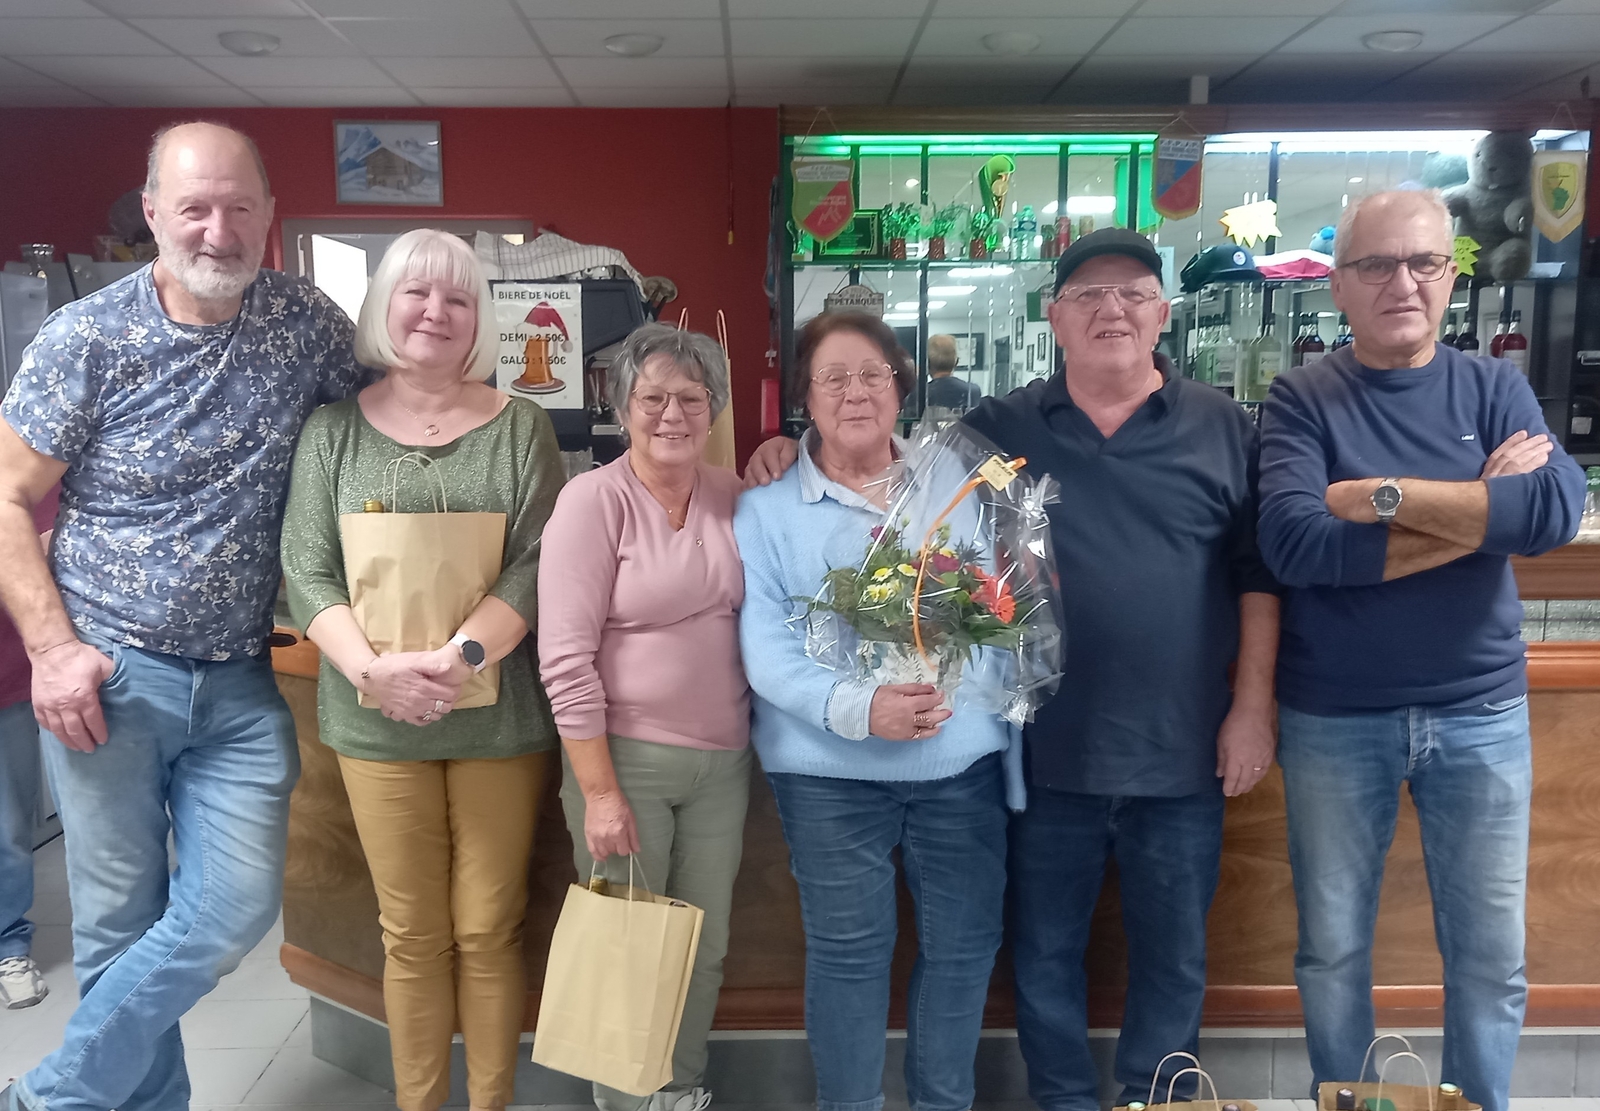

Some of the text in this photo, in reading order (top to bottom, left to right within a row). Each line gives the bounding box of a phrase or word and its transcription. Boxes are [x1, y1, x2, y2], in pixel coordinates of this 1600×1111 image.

[528, 291, 543, 300] DE
[500, 333, 527, 342] DEMI
[500, 356, 530, 365] GALO
